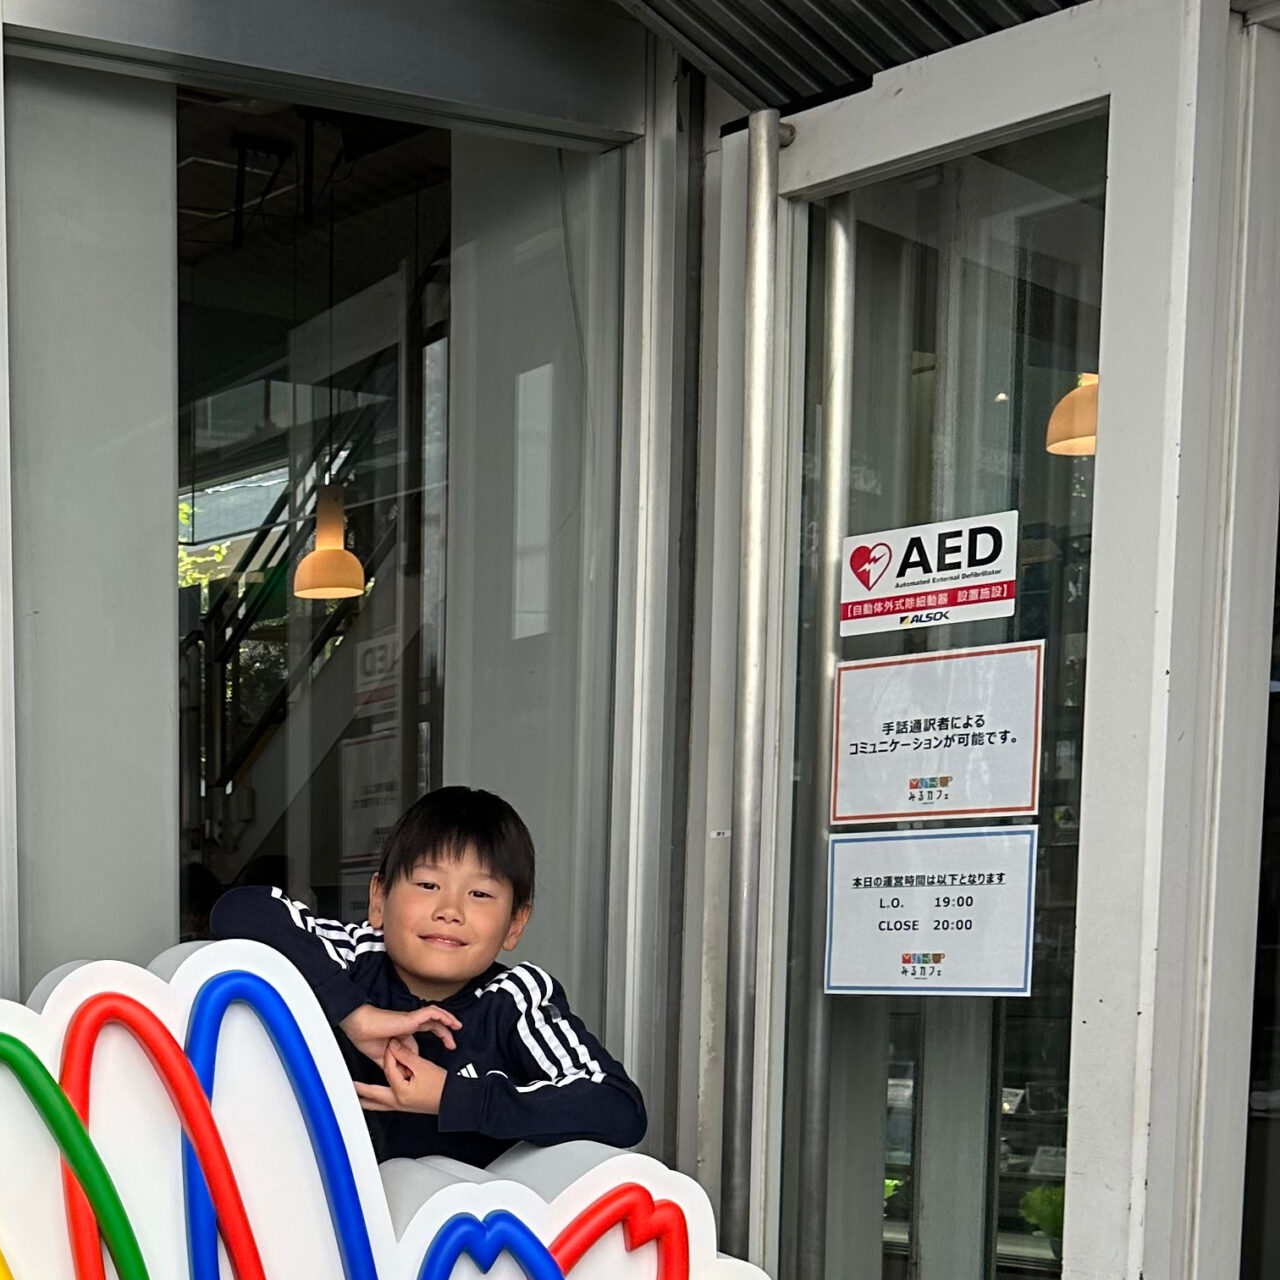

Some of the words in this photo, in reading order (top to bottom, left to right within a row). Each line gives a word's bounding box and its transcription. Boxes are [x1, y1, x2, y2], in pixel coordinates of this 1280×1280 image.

[896, 526, 1003, 578] AED
[895, 578, 931, 589] Automated
[932, 574, 960, 584] External
[961, 569, 1002, 580] Defibrillator
[910, 610, 950, 625] ALSOK
[881, 714, 986, 736] 手話通訳者による
[849, 729, 1018, 756] コミュニケーションが可能です。
[851, 872, 1006, 888] 本日の運営時間は以下となります
[879, 897, 905, 909] L.O.
[934, 896, 974, 908] 19:00
[878, 920, 920, 931] CLOSE
[933, 919, 973, 931] 20:00
